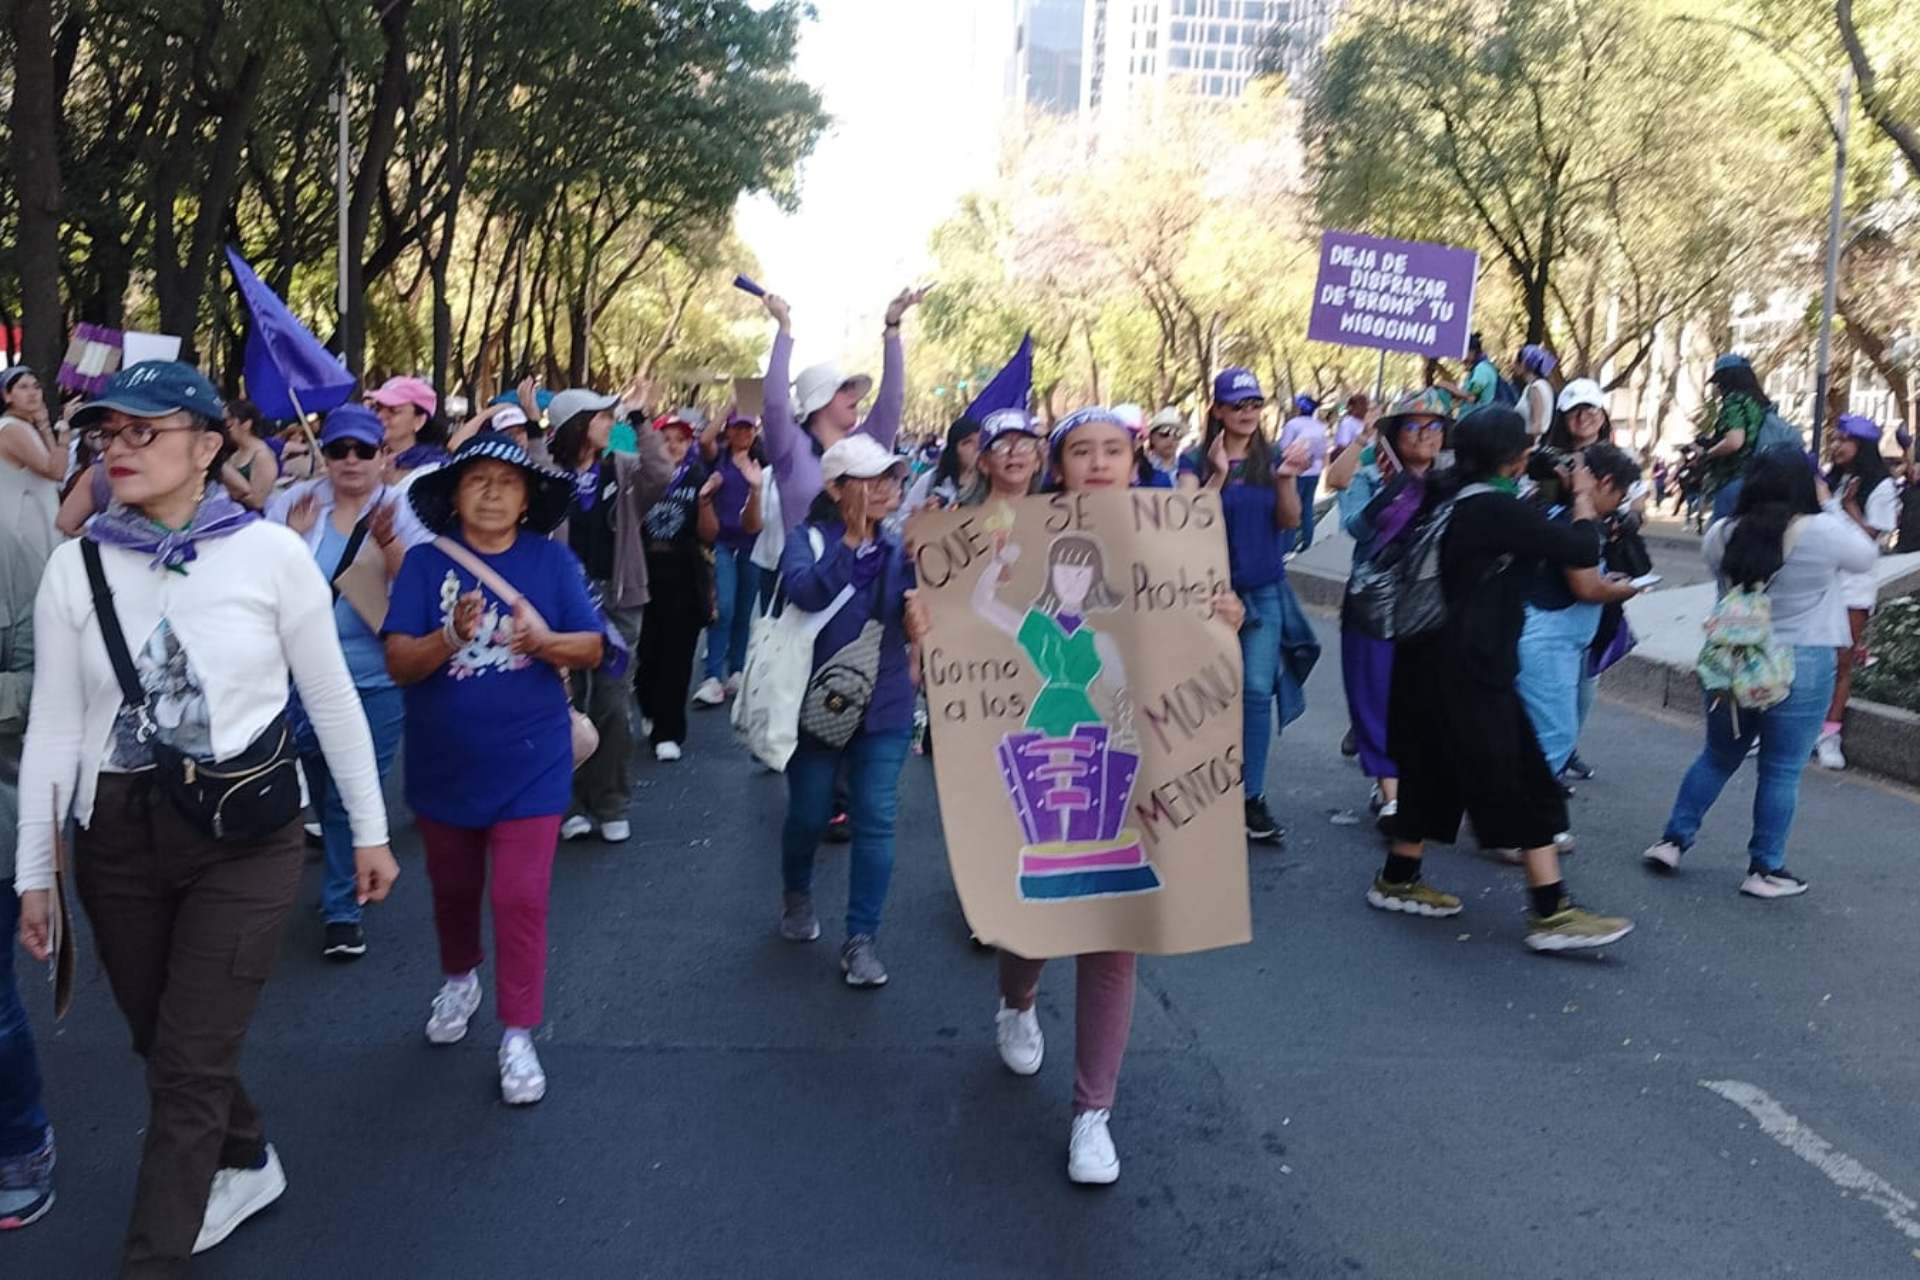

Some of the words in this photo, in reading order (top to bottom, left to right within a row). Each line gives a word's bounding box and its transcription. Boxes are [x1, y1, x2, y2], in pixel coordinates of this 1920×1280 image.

[1329, 244, 1377, 271] DEJA
[1381, 252, 1408, 275] DE
[1350, 268, 1447, 300] DISFRAZAR
[1320, 284, 1347, 307] DE
[1429, 300, 1454, 322] TU
[1340, 312, 1437, 345] MISOGINIA
[917, 518, 989, 589] QUE
[1046, 493, 1096, 533] SE
[1131, 492, 1215, 532] NOS
[929, 648, 1020, 687] Como
[981, 692, 1026, 719] los
[1135, 744, 1244, 844] MENTOS
